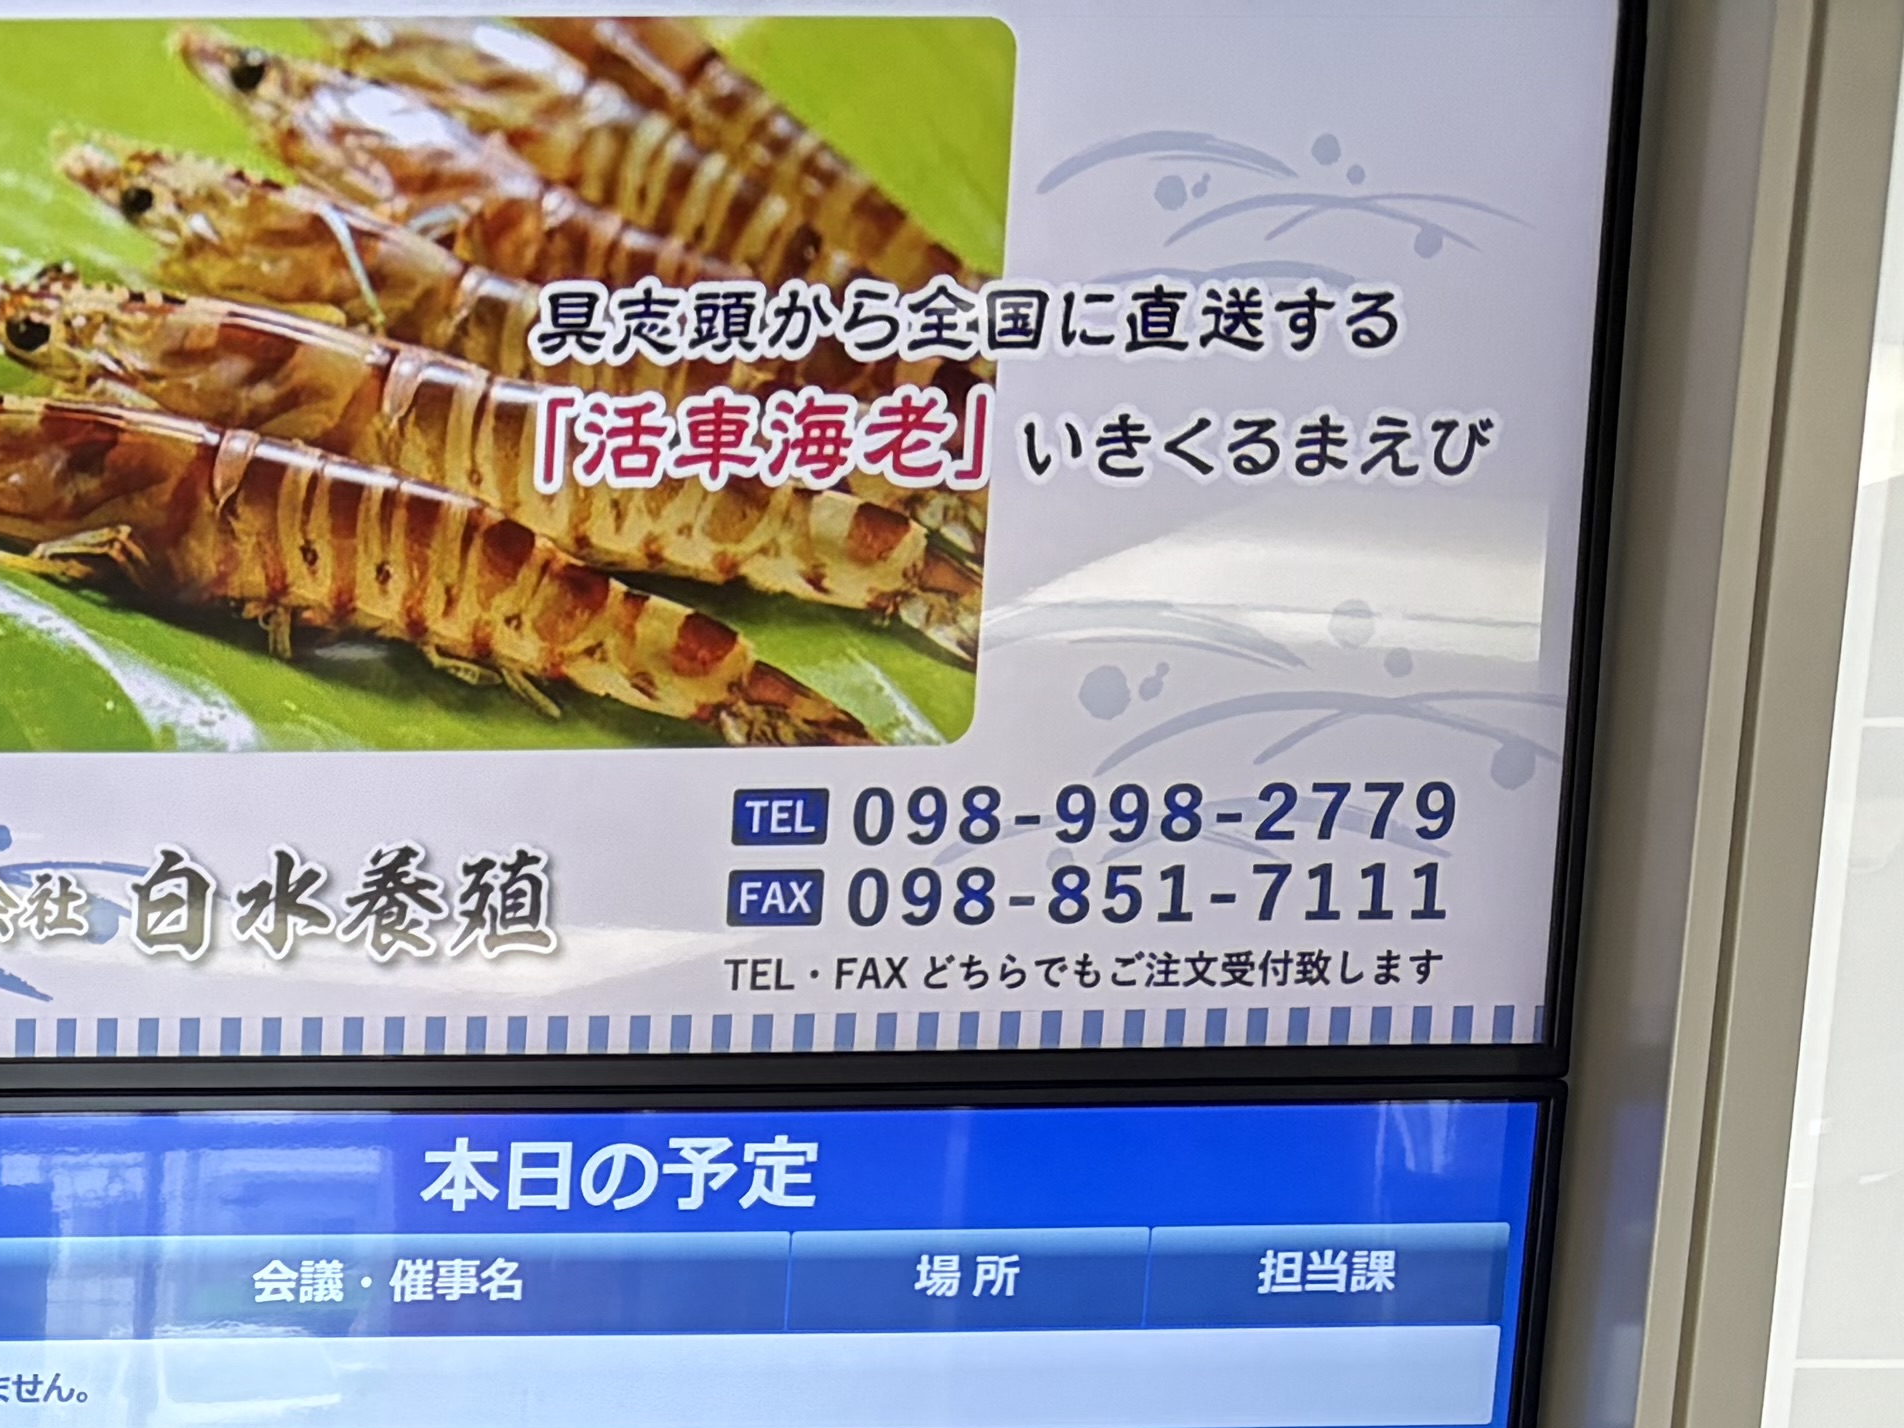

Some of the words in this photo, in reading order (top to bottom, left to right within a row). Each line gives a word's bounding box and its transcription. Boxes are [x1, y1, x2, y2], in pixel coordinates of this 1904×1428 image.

[536, 281, 1403, 357] 具志頭から全国に直送する
[535, 386, 992, 489] 「活車海老」
[1022, 409, 1495, 482] いきくるまえび
[743, 799, 818, 836] TEL
[851, 780, 1458, 851] 098-998-2779
[130, 846, 558, 958] 白水養殖
[738, 879, 816, 916] FAX
[846, 861, 1451, 931] 098-851-7111
[922, 946, 1443, 994] どちらでもご注文受付致します
[420, 1136, 821, 1213] 本日の予定
[251, 1256, 526, 1305] 会議・催事名
[1257, 1247, 1399, 1296] 担当課
